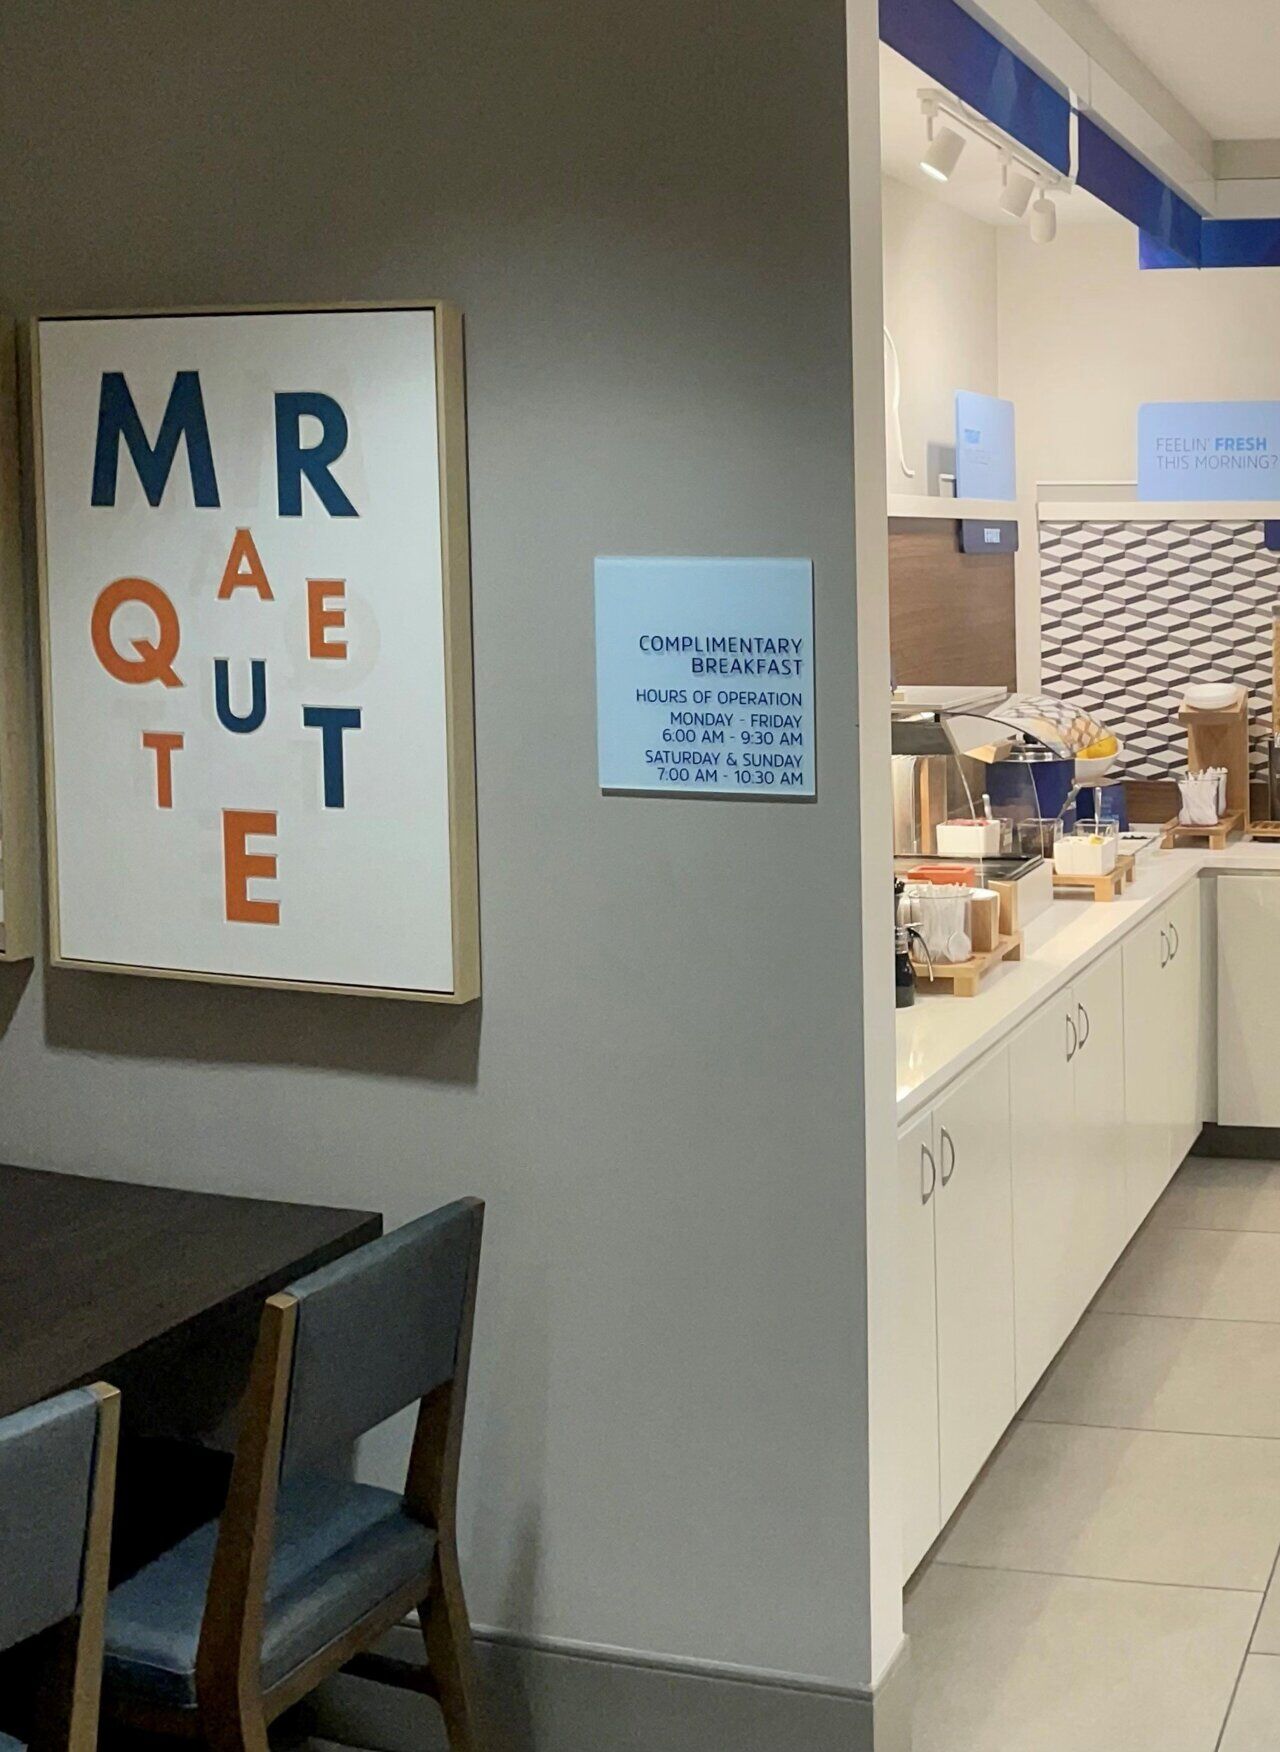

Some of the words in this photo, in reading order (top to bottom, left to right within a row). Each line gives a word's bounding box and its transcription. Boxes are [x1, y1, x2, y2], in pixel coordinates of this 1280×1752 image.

[90, 370, 220, 509] M
[274, 391, 360, 518] R
[1156, 437, 1210, 452] FEELIN'
[1214, 437, 1267, 451] FRESH
[1156, 455, 1189, 470] THIS
[1195, 454, 1279, 470] MORNING?
[217, 528, 274, 601] A
[90, 577, 183, 688] Q
[307, 578, 347, 660] E
[639, 635, 803, 655] COMPLIMENTARY
[692, 657, 803, 676] BREAKFAST
[214, 658, 267, 734] U
[636, 688, 687, 704] HOURS
[693, 690, 712, 704] OF
[717, 691, 802, 707] OPERATION
[670, 712, 734, 727] MONDAY
[750, 714, 803, 729] FRIDAY
[662, 729, 696, 744] 6:00
[701, 730, 724, 744] AM
[741, 731, 774, 745] 9:30
[780, 732, 803, 746] AM
[143, 732, 184, 809] T
[303, 706, 361, 809] T
[645, 750, 721, 766] SATURDAY
[726, 752, 738, 766] &
[742, 753, 803, 768] SUNDAY
[694, 768, 718, 783] AM
[734, 770, 775, 785] 10:30
[780, 771, 803, 786] AM
[223, 808, 281, 926] E
